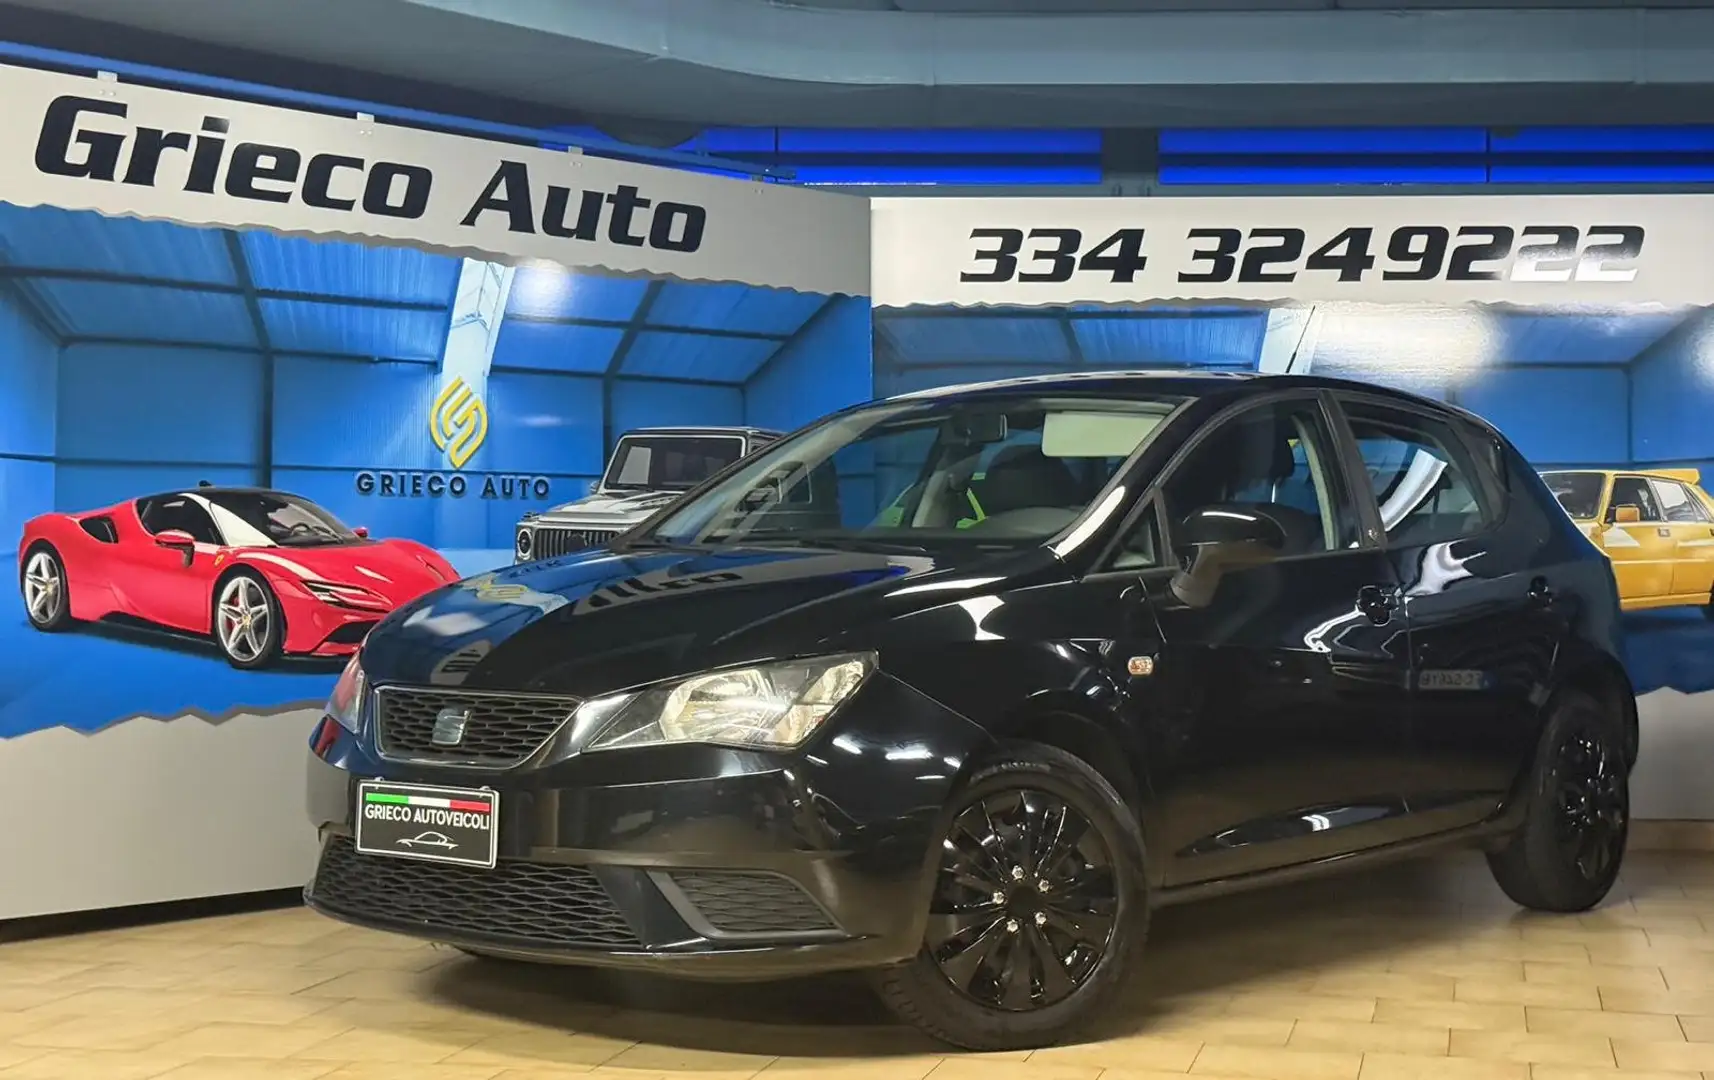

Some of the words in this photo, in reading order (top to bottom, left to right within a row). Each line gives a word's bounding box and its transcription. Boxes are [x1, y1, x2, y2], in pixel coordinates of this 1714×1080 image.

[35, 95, 432, 219] Grieco
[460, 160, 707, 253] Auto
[960, 228, 1147, 283] 334
[1178, 225, 1646, 283] 3249222
[356, 472, 467, 497] GRIECO
[481, 475, 550, 499] AUTO
[364, 804, 411, 821] GRIECO
[413, 809, 490, 829] AUTOVEICOLI
